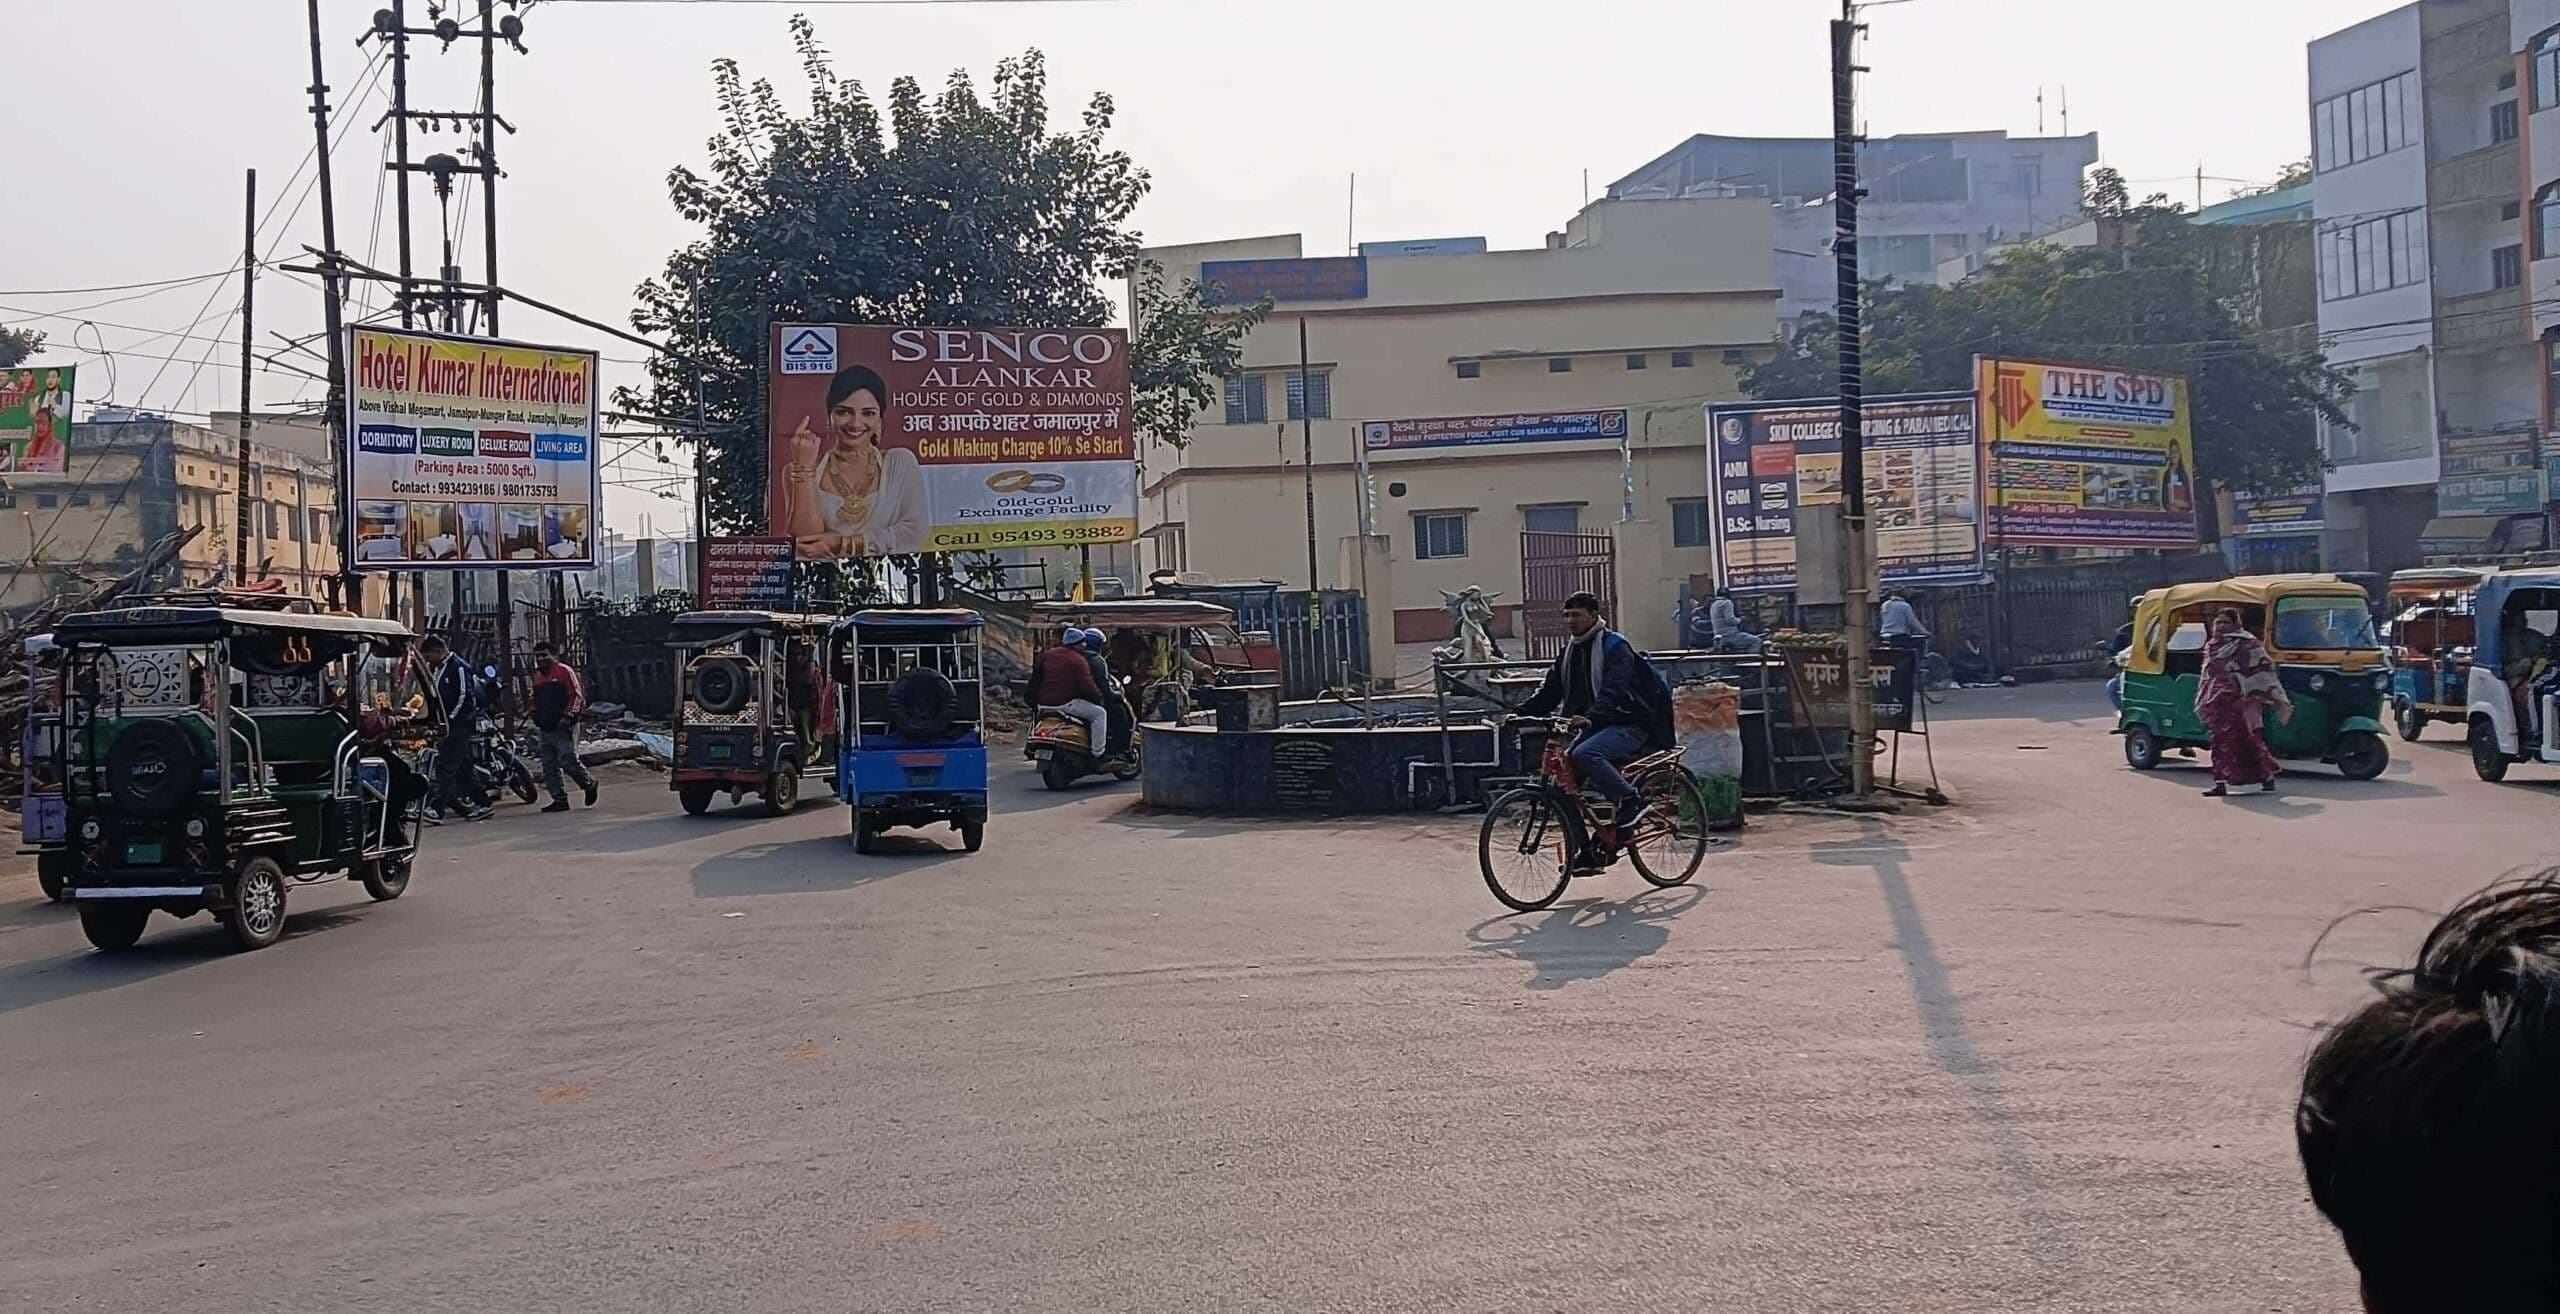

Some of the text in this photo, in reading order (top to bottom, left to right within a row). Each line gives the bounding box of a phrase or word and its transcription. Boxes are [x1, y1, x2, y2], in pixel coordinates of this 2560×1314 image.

[892, 330, 1112, 364] SENCO
[360, 338, 587, 405] Hotel Kumar International
[786, 361, 833, 371] BIS 916
[920, 367, 1096, 388] ALANKAR
[2048, 370, 2165, 404] THE SPD
[893, 392, 1125, 407] HOUSE OF GOLD & DIAMONDS
[359, 398, 381, 412] Above
[383, 400, 407, 414] Vishal
[408, 402, 446, 420] Megamart,
[448, 404, 506, 424] Jamalpur-Munger
[507, 409, 525, 424] Road,
[559, 412, 588, 429] (Munger)
[903, 407, 1121, 436] अब आपके शहर जमालपुर में
[1769, 423, 1790, 441] SKM
[1791, 421, 1834, 441] COLLEGE
[1894, 418, 1902, 435] &
[1903, 414, 1971, 434] PARAMEDICAL
[361, 431, 414, 448] DORMITORY
[422, 434, 473, 450] LUXERY ROOM
[480, 438, 530, 453] DELUXE ROOM
[536, 440, 583, 454] LIVING AREA
[919, 436, 1124, 461] Gold Making Charge 10% Se Start
[415, 459, 454, 476] (Parking
[456, 462, 478, 474] Area
[487, 462, 509, 476] 5000
[511, 463, 536, 480] Sqft.)
[1724, 461, 1749, 478] ANM
[392, 480, 430, 494] Contact
[438, 482, 496, 496] 9934239186
[502, 484, 558, 498] 9801735793
[1726, 488, 1751, 505] GNM
[997, 495, 1073, 507] Old-Gold
[959, 503, 1113, 519] Exchange Facility
[1727, 514, 1791, 533] B.Sc. Nursing
[934, 526, 1125, 546] Call 95493 93882
[1803, 655, 1841, 695] मुंगेर
